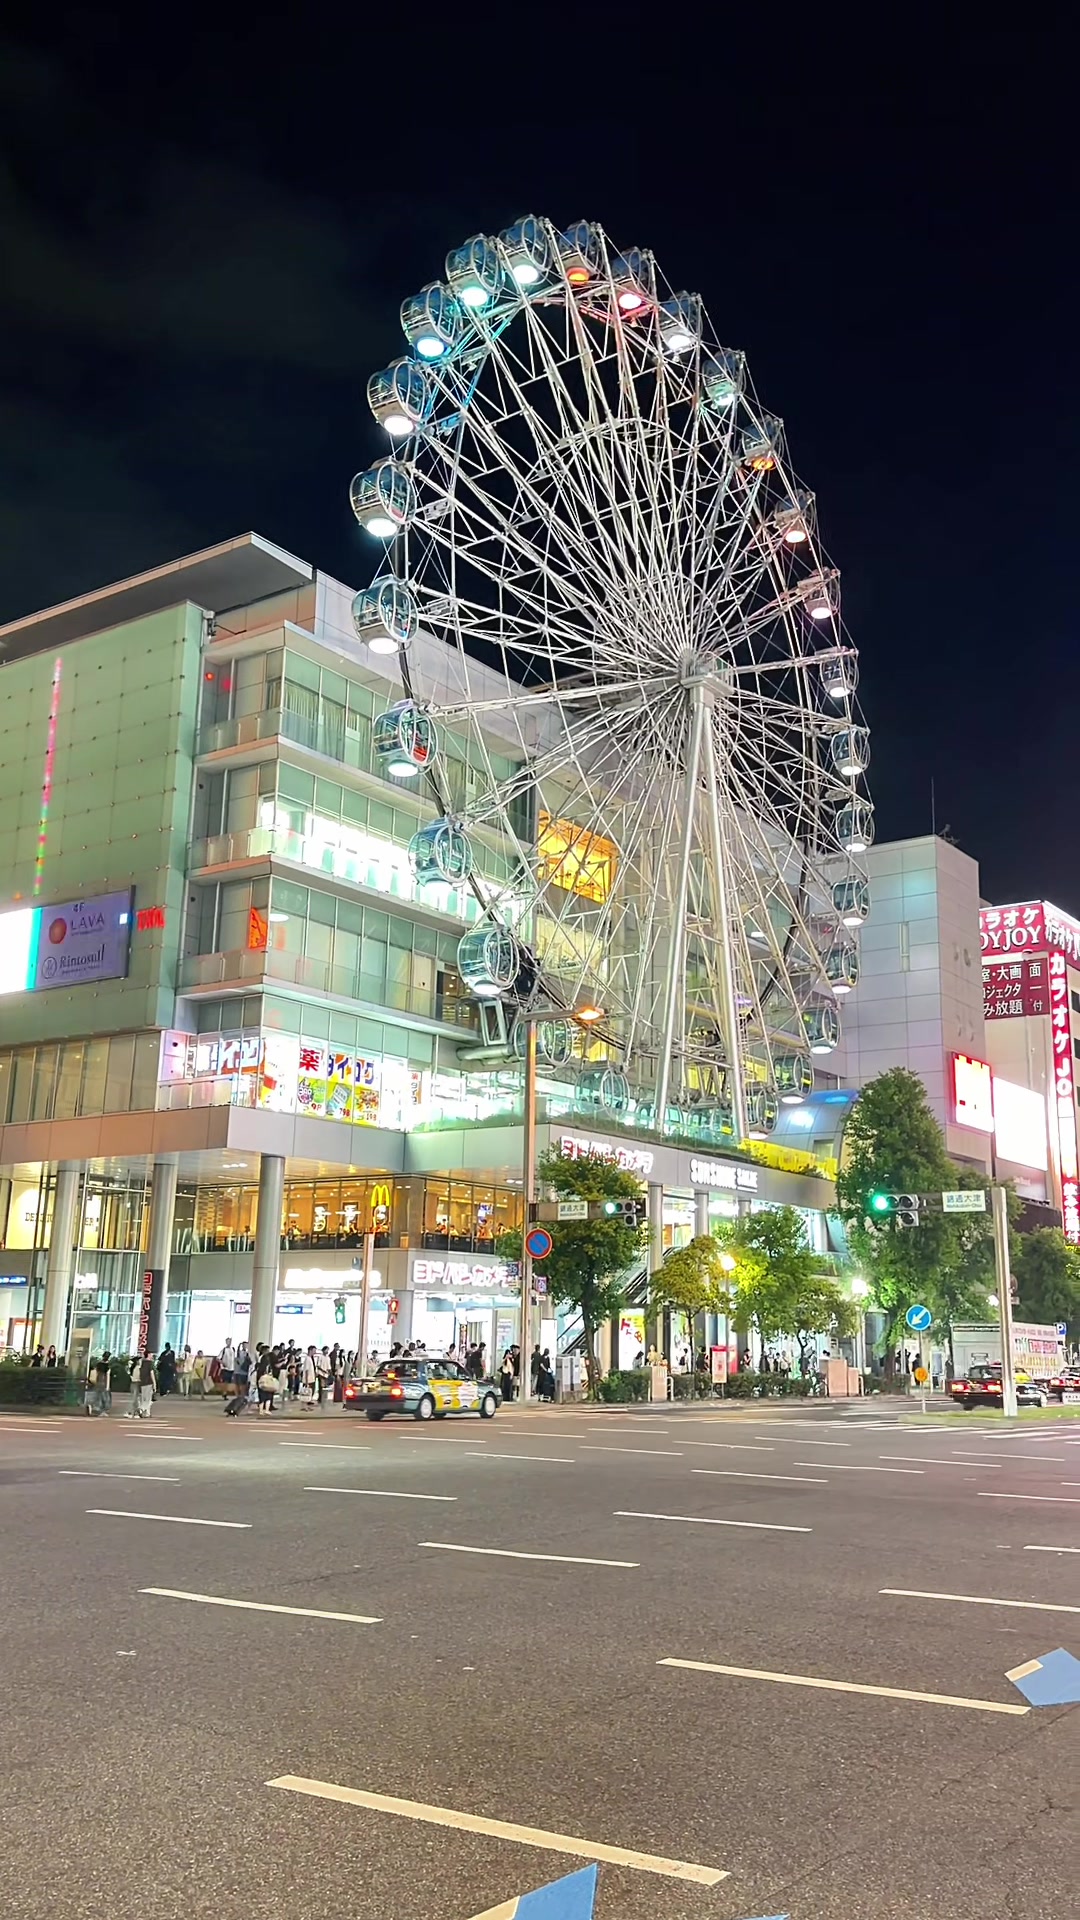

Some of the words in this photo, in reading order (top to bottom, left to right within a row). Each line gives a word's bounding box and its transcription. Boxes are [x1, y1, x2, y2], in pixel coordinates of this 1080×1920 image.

[71, 912, 106, 931] LAVA
[979, 907, 1040, 930] ラオケ
